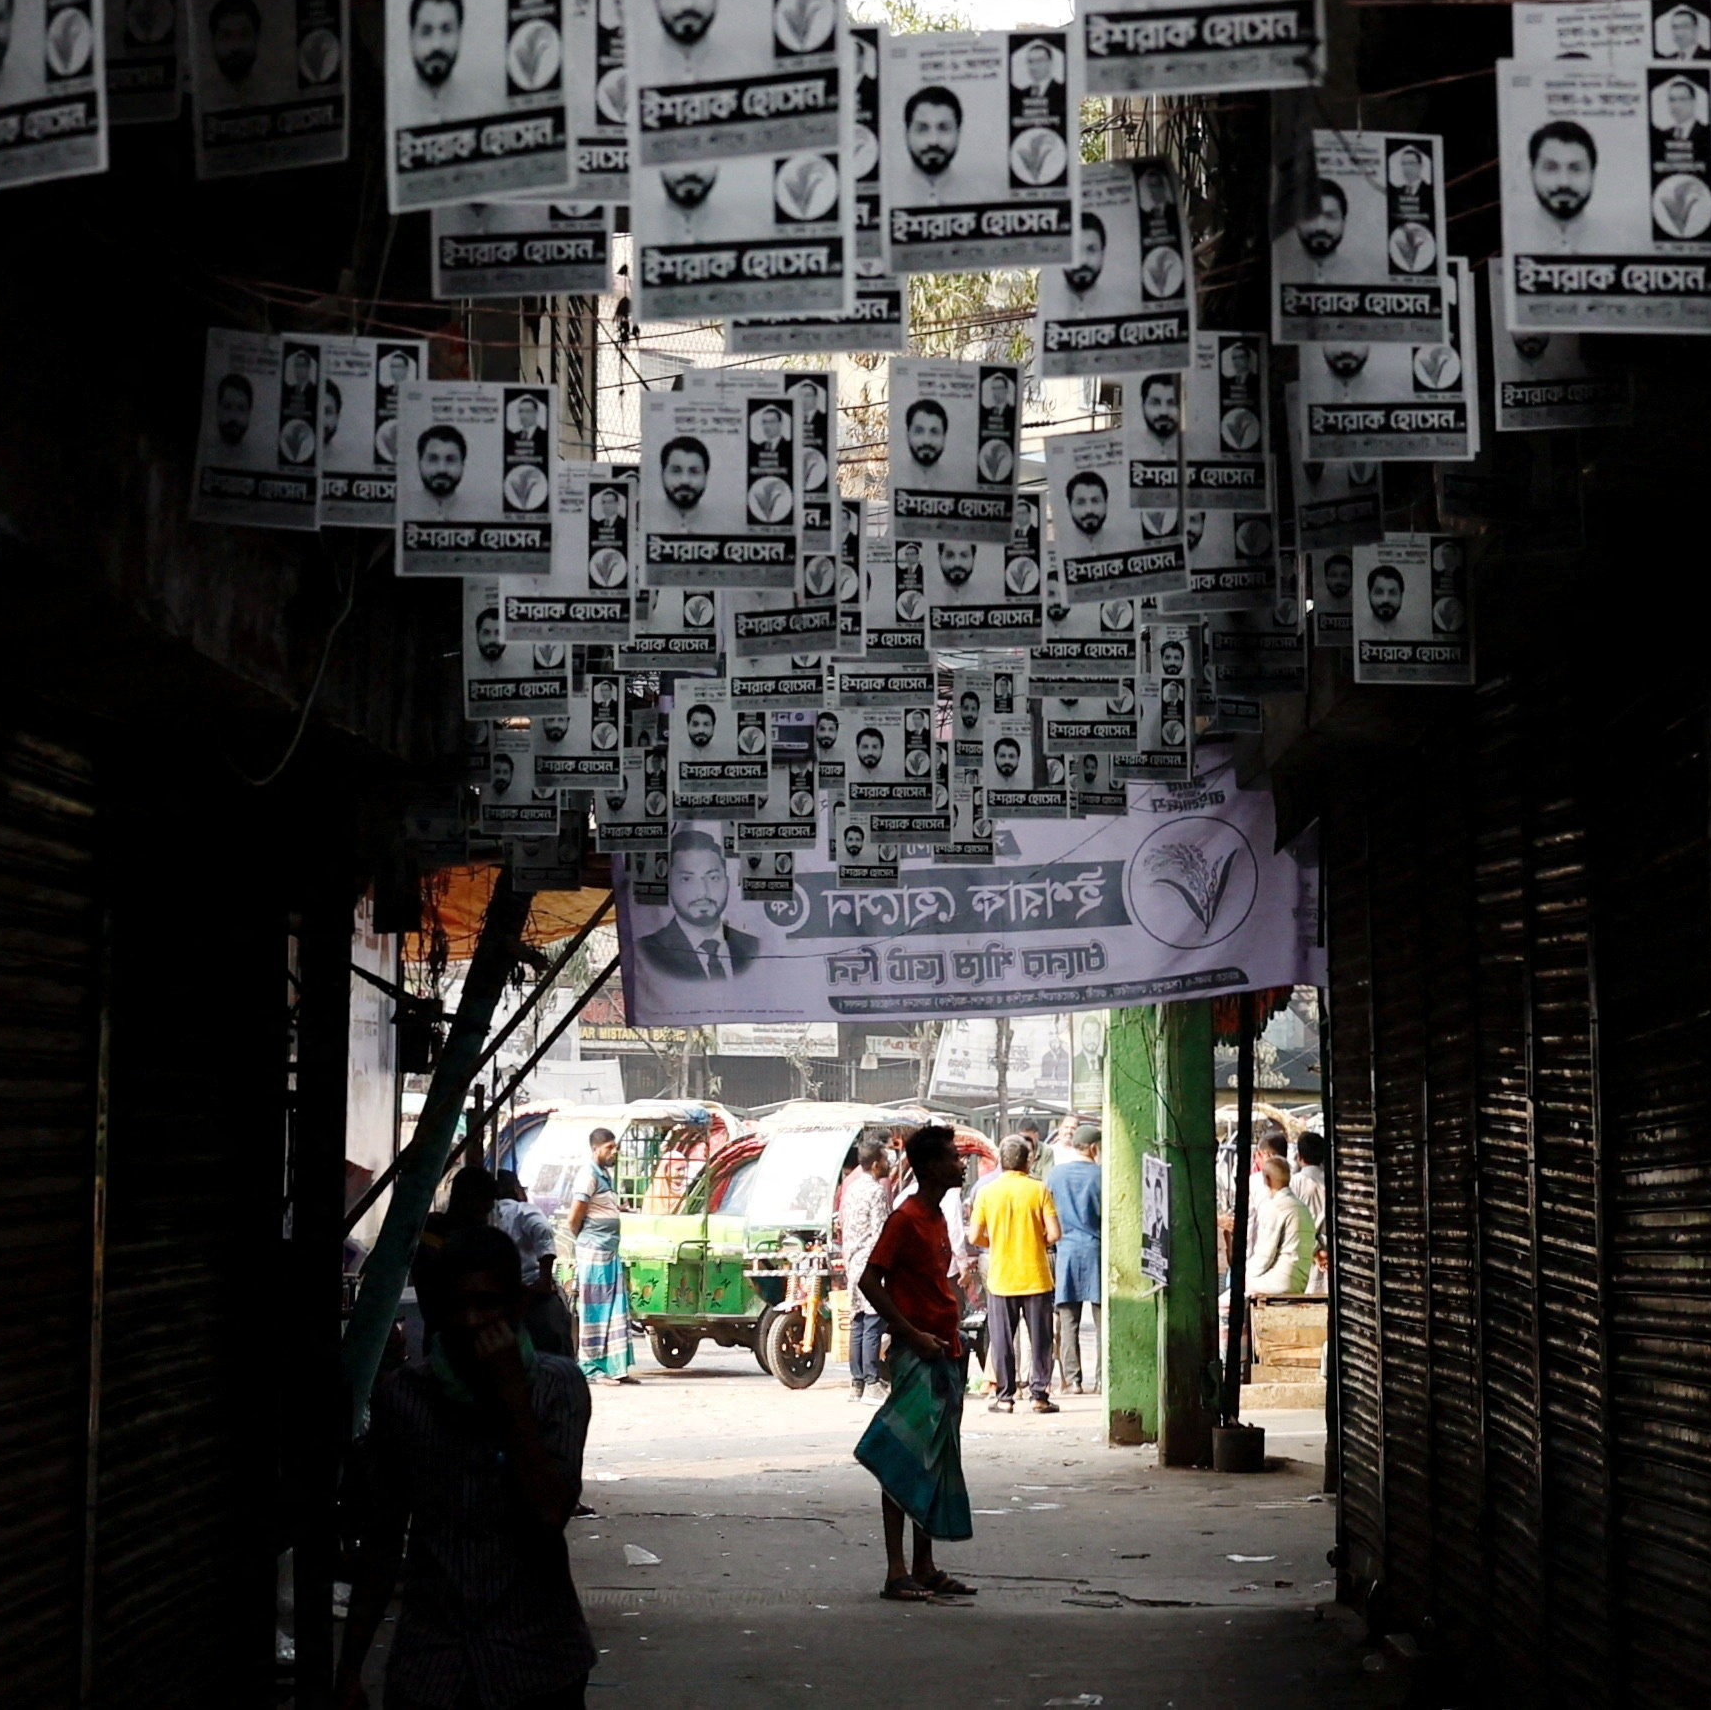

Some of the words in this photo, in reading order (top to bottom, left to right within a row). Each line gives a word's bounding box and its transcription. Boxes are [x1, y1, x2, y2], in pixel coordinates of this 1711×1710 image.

[1087, 13, 1198, 60] ইশরাক
[1200, 5, 1301, 48] হোসেন
[641, 89, 740, 129] ইশরাক
[742, 78, 828, 117] হোসেন
[397, 128, 480, 171] ইশরাক
[480, 116, 556, 156] হোসেন
[892, 208, 977, 243] ইশরাক
[981, 208, 1059, 237] হোসেন
[440, 240, 518, 268] ইশরাক
[523, 238, 594, 265] হোসেন
[642, 249, 738, 286] ইশরাক
[740, 246, 831, 280] হোসেন
[1516, 260, 1616, 294] ইশরাক
[1621, 262, 1707, 293] হোসেন
[1282, 289, 1360, 315] ইশরাক
[1364, 292, 1430, 315] হোসেন
[1045, 322, 1117, 352] ইশরাক
[1118, 318, 1180, 345] হোসেন
[1310, 407, 1386, 434] ইশরাক
[1390, 409, 1455, 433] হোসেন
[1200, 466, 1256, 487] হোসেন
[895, 491, 955, 518] ইশরাক
[957, 495, 1007, 519] হোসেন
[404, 524, 477, 551] ইশরাক
[480, 528, 541, 549] হোসেন
[647, 536, 719, 564] ইশরাক
[723, 540, 787, 563] হোসেন
[1067, 558, 1125, 583] ইশরাক
[1128, 552, 1176, 573] হোসেন
[506, 599, 567, 621] ইশরাক
[569, 603, 622, 621] হোসেন
[930, 608, 985, 628] ইশরাক
[987, 608, 1034, 627] হোসেন
[737, 613, 788, 636] ইশরাক
[790, 611, 831, 632] হোসেন
[1084, 642, 1129, 658] হোসেন
[1360, 642, 1413, 662] ইশরাক
[1416, 646, 1461, 663] হোসেন
[470, 682, 517, 700] ইশরাক
[518, 681, 561, 697] হোসেন
[733, 679, 776, 696] ইশরাক
[778, 678, 817, 693] হোসেন
[841, 674, 886, 691] ইশরাক
[888, 676, 928, 691] হোসেন
[1049, 723, 1091, 738] ইশরাক
[1093, 724, 1131, 738] হোসেন
[681, 763, 723, 779] ইশরাক
[724, 764, 762, 779] হোসেন
[850, 783, 890, 799] ইশরাক
[892, 786, 926, 799] হোসেন
[988, 791, 1026, 806] ইশরাক
[1028, 793, 1062, 804] হোসেন
[739, 824, 776, 838] ইশরাক
[778, 826, 811, 838] হোসেন
[872, 816, 910, 831] ইশরাক
[912, 818, 945, 830] হোসেন
[840, 866, 870, 878] ইশরাক
[871, 868, 895, 878] হোসেন
